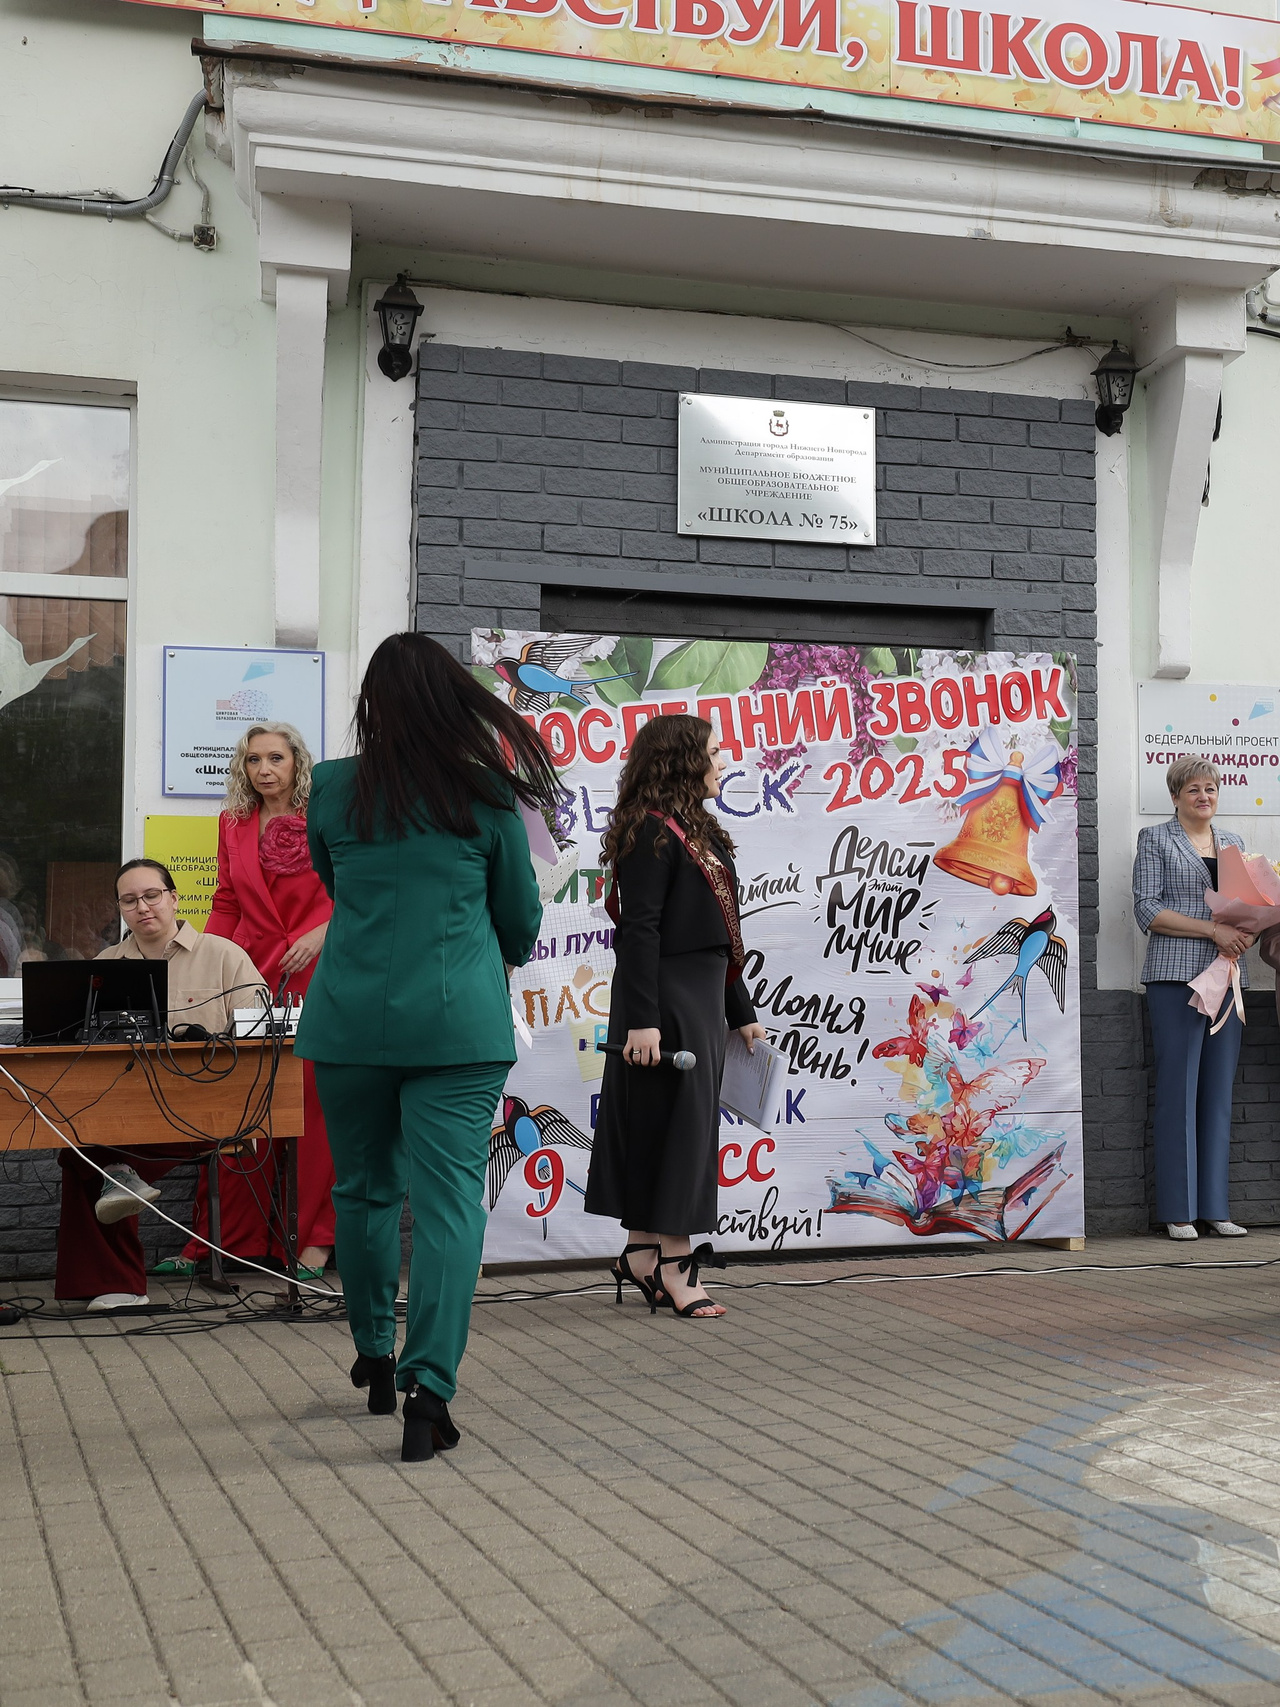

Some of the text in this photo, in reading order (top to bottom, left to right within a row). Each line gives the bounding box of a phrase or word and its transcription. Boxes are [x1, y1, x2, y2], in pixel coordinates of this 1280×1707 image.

[894, 0, 1245, 109] ШКОЛА!
[699, 436, 867, 457] Администрация города Нижнего Новгорода
[734, 448, 834, 463] Департамент образования
[699, 466, 857, 484] МУНИЦИПАЛЬНОЕ БЮДЖЕТНОЕ
[717, 477, 839, 493] ОБЩЕОБРАЗОВАТЕЛЬНОЕ
[745, 489, 813, 501] УЧРЕЖДЕНИЕ
[697, 506, 858, 531] «ШКОЛА № 75»
[869, 667, 1069, 736] ЗВОНОК
[1144, 733, 1279, 747] ФЕДЕРАЛЬНЫЙ ПРОЕКТ
[823, 748, 970, 813] 2025
[170, 856, 218, 864] МУНИЦИП
[523, 1149, 565, 1218] 9
